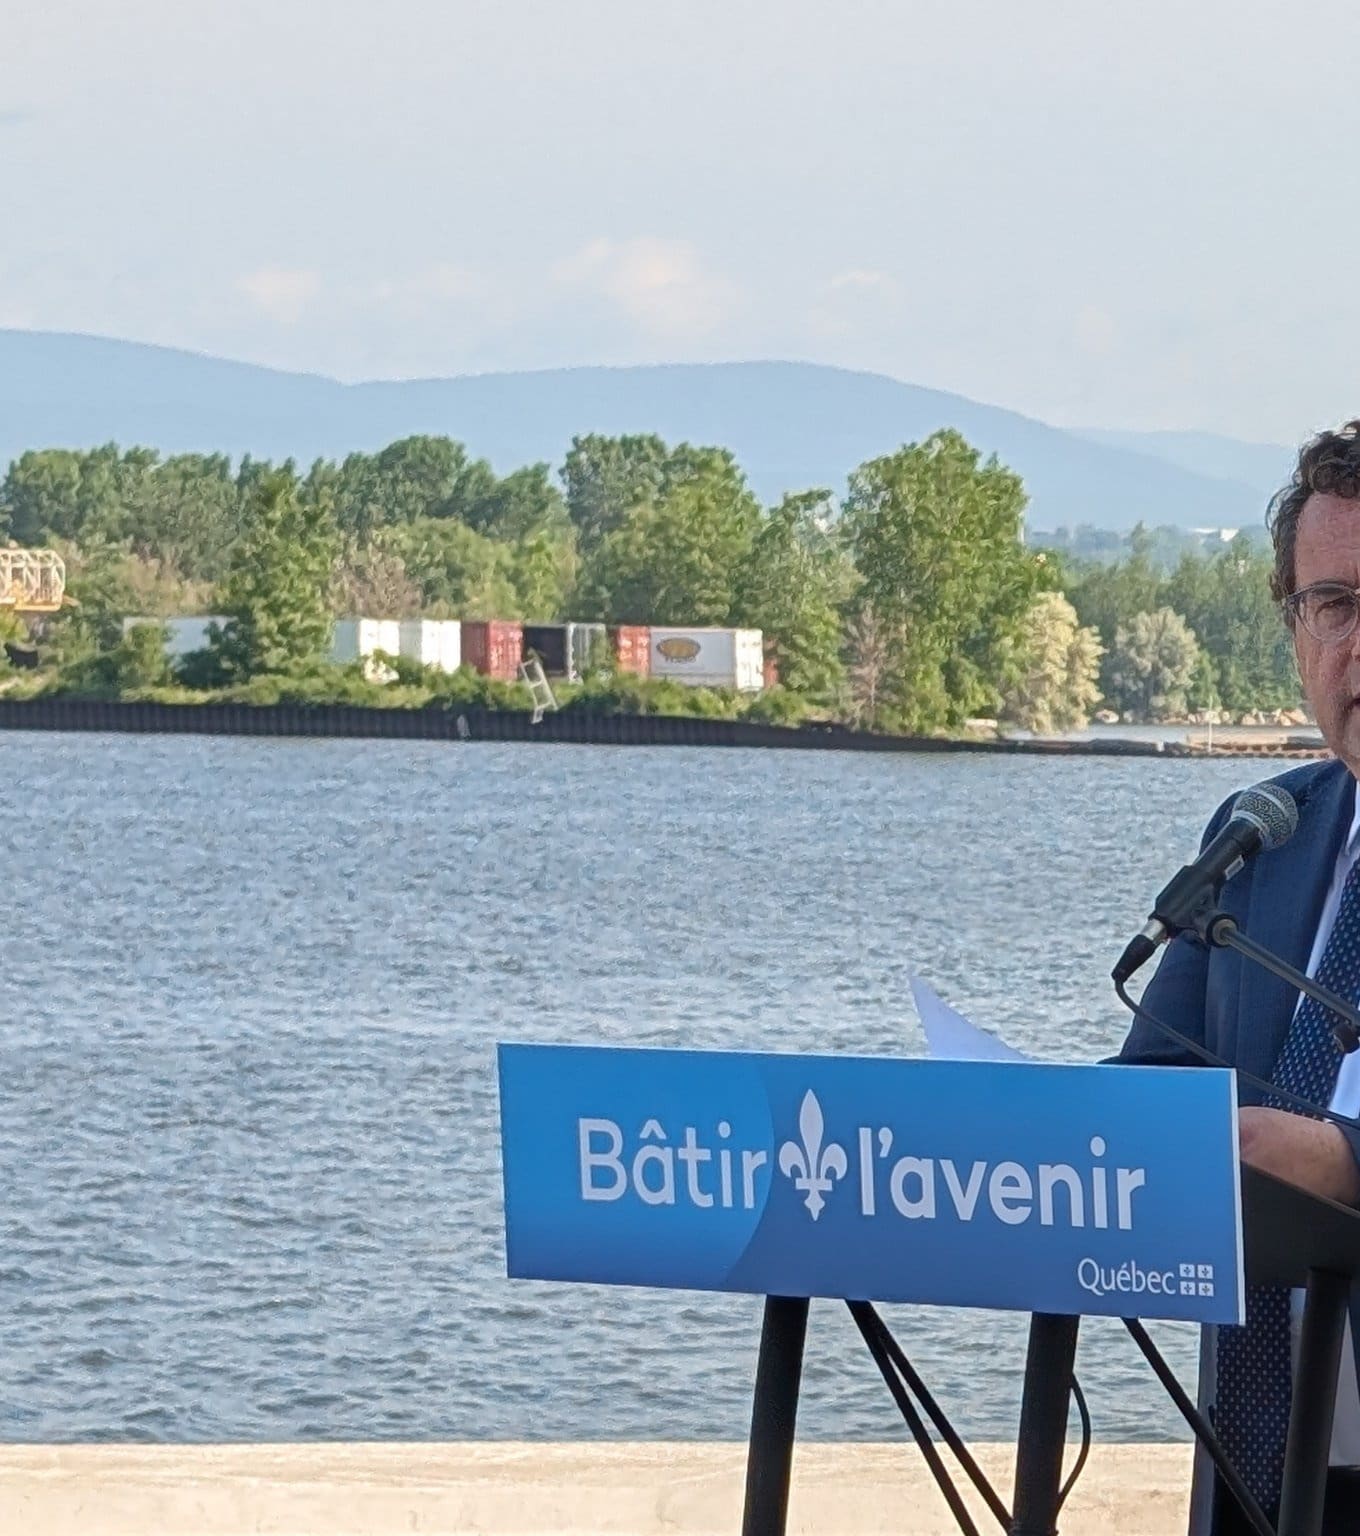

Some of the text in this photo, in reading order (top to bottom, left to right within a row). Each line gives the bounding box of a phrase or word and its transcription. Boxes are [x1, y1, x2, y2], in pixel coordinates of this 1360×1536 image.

[577, 1116, 1147, 1231] Bâtir l'avenir
[1077, 1257, 1177, 1297] Québec
